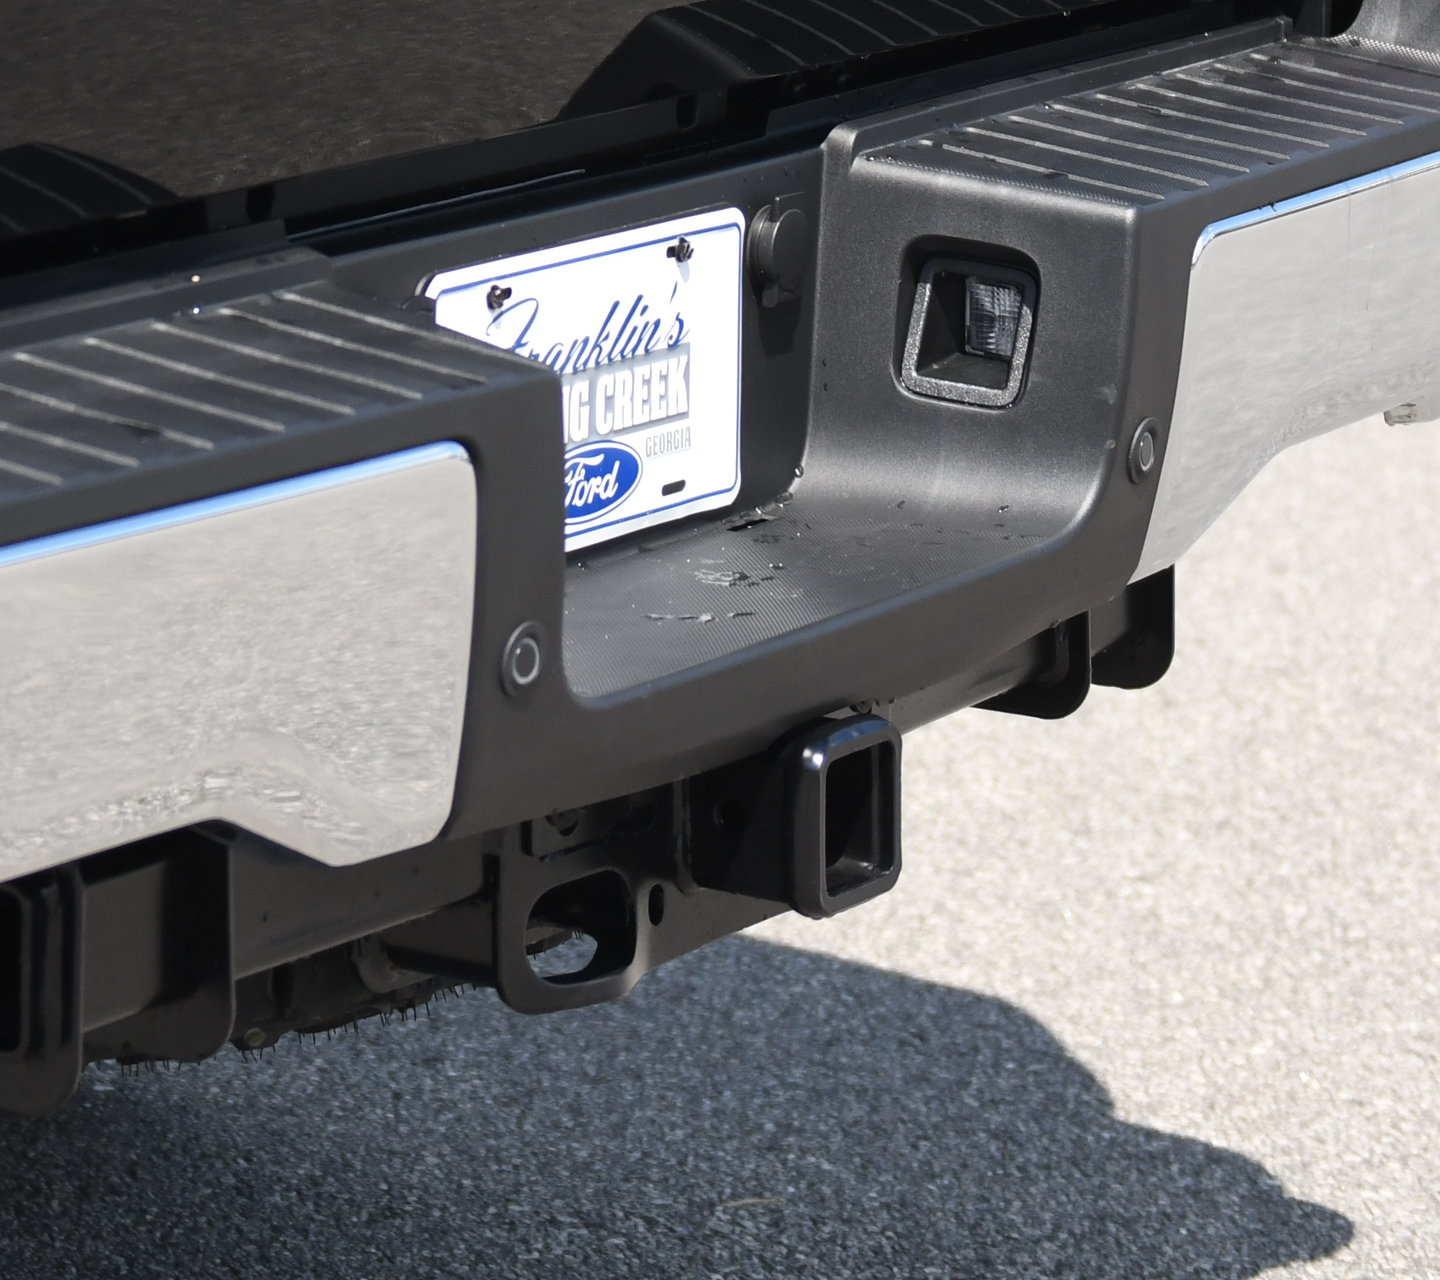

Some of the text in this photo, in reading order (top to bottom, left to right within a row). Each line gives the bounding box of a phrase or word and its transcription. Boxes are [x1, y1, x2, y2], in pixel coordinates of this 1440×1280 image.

[595, 354, 689, 436] CREEK
[645, 427, 692, 459] GEORGIA
[564, 453, 621, 508] Ford
